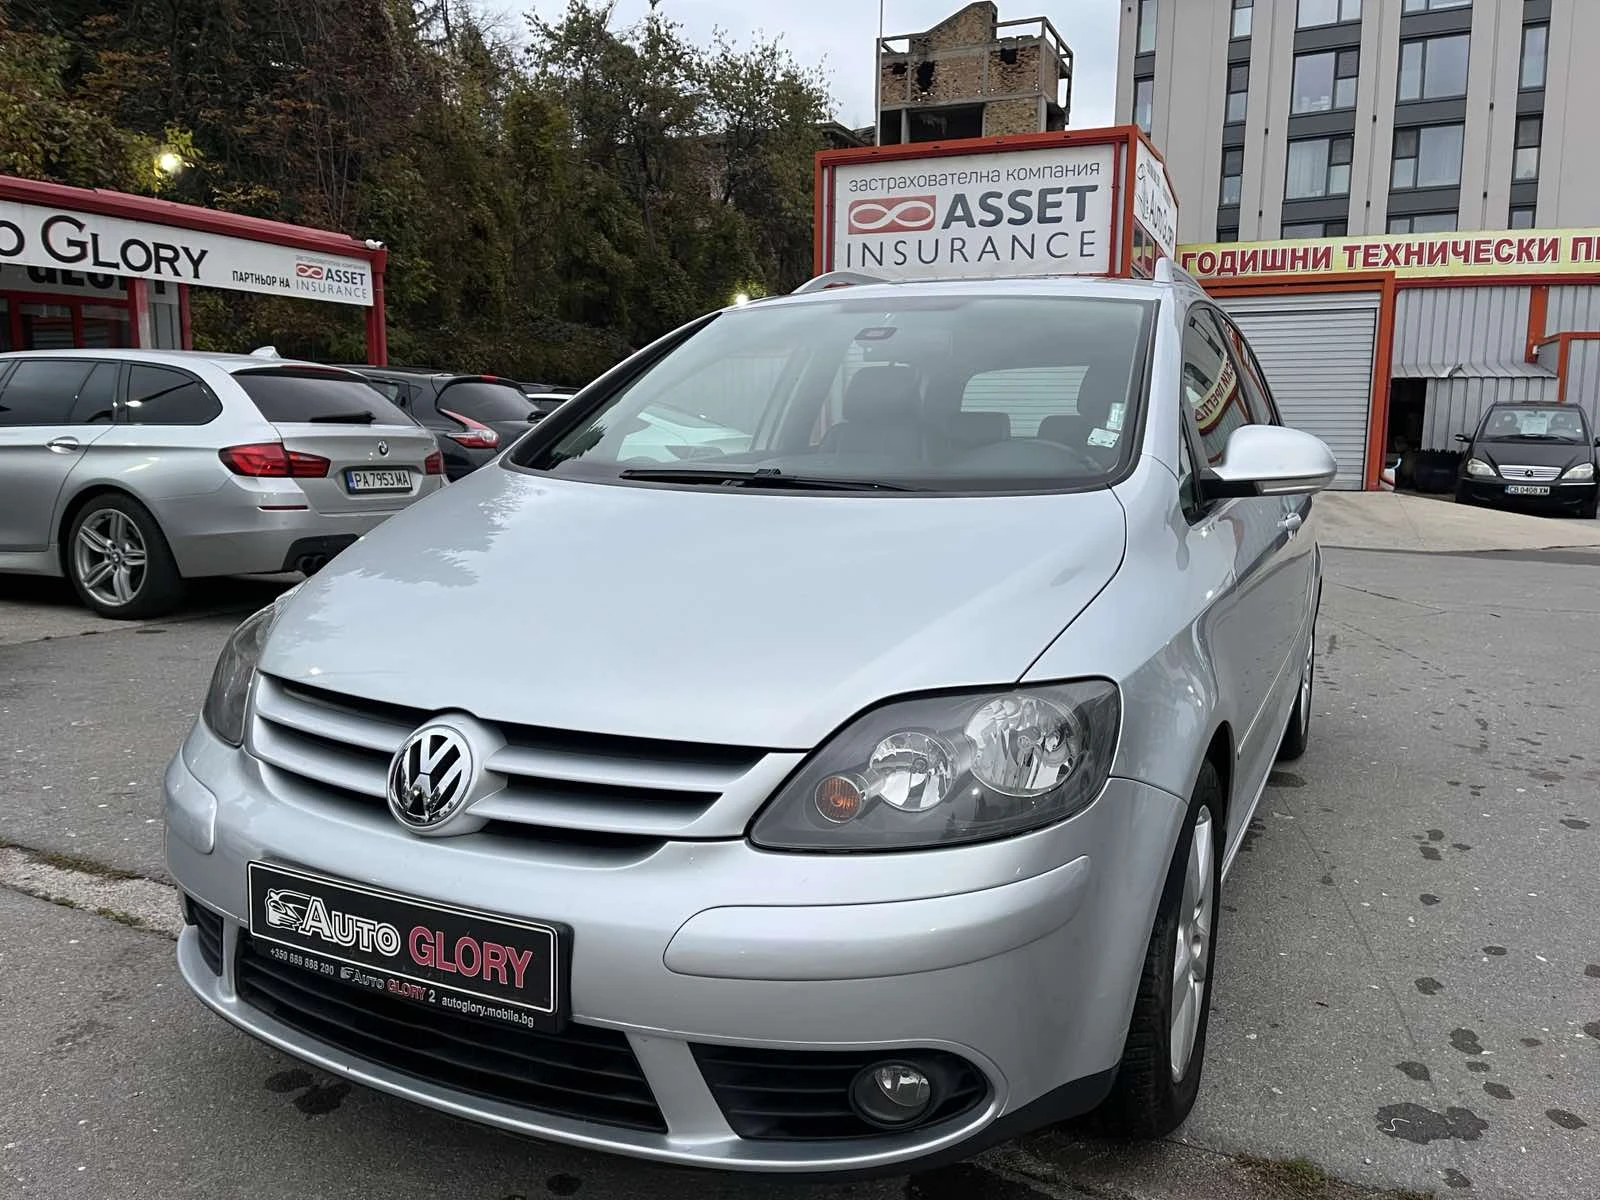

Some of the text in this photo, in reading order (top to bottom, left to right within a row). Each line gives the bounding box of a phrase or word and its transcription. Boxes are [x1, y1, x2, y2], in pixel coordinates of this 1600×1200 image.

[849, 162, 1100, 194] застрахователна компания
[941, 184, 1099, 230] ASSET
[41, 214, 209, 279] GLORY
[847, 230, 1096, 269] INSURANCE
[1181, 235, 1600, 276] ГОДИШНИ ТЕХНИЧЕСКИ П
[232, 270, 291, 289] ПАРТНЬОР НА
[295, 279, 368, 299] INSURANCE
[325, 268, 366, 286] ASSET
[408, 925, 533, 989] GLORY
[270, 948, 288, 961] +359
[320, 962, 334, 976] 290
[386, 978, 427, 1001] GLORY
[428, 989, 436, 1003] 2
[441, 996, 534, 1028] autoglory.mobile.bg
